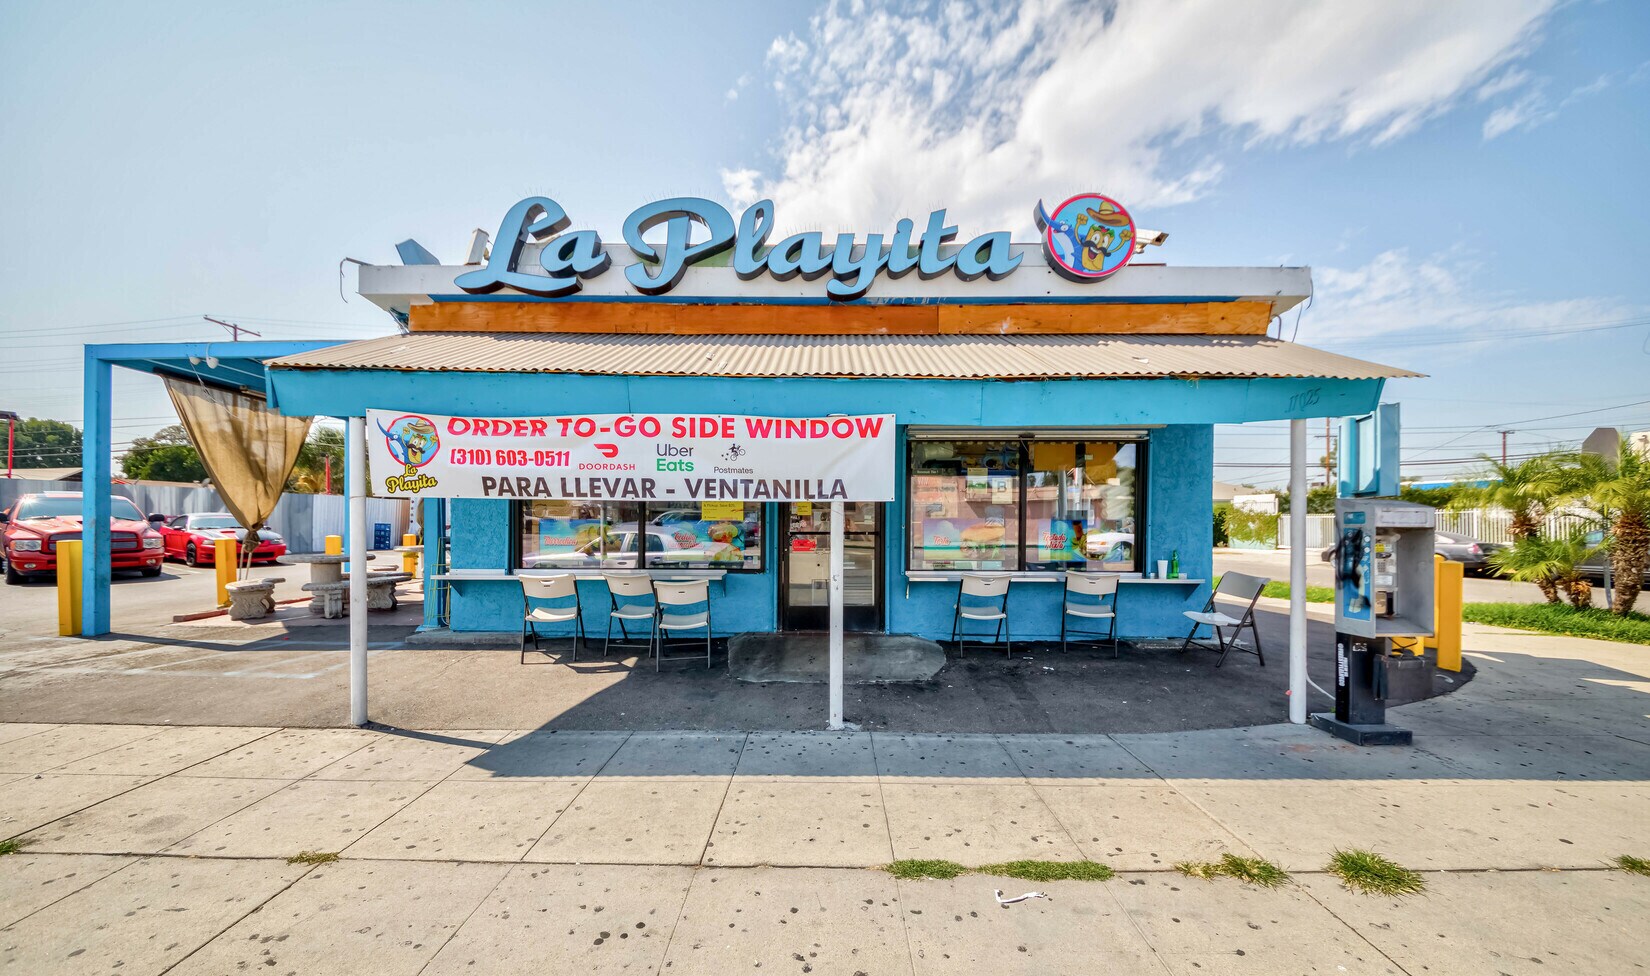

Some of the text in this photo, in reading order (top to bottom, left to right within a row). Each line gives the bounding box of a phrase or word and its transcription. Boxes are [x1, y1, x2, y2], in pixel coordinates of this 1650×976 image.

[454, 196, 1024, 298] La Playita
[447, 416, 883, 439] ORDER TO-GO SIDE WINDOW
[450, 449, 570, 467] (310) 603-0511
[656, 443, 694, 457] Uber
[404, 463, 418, 477] La
[579, 463, 635, 471] DOORDASH
[656, 458, 694, 472] Eats
[713, 466, 753, 474] Postmates
[385, 475, 438, 493] Playita
[481, 476, 552, 497] PARA
[560, 477, 656, 498] LLEVAR
[685, 478, 848, 499] VENTANILLA
